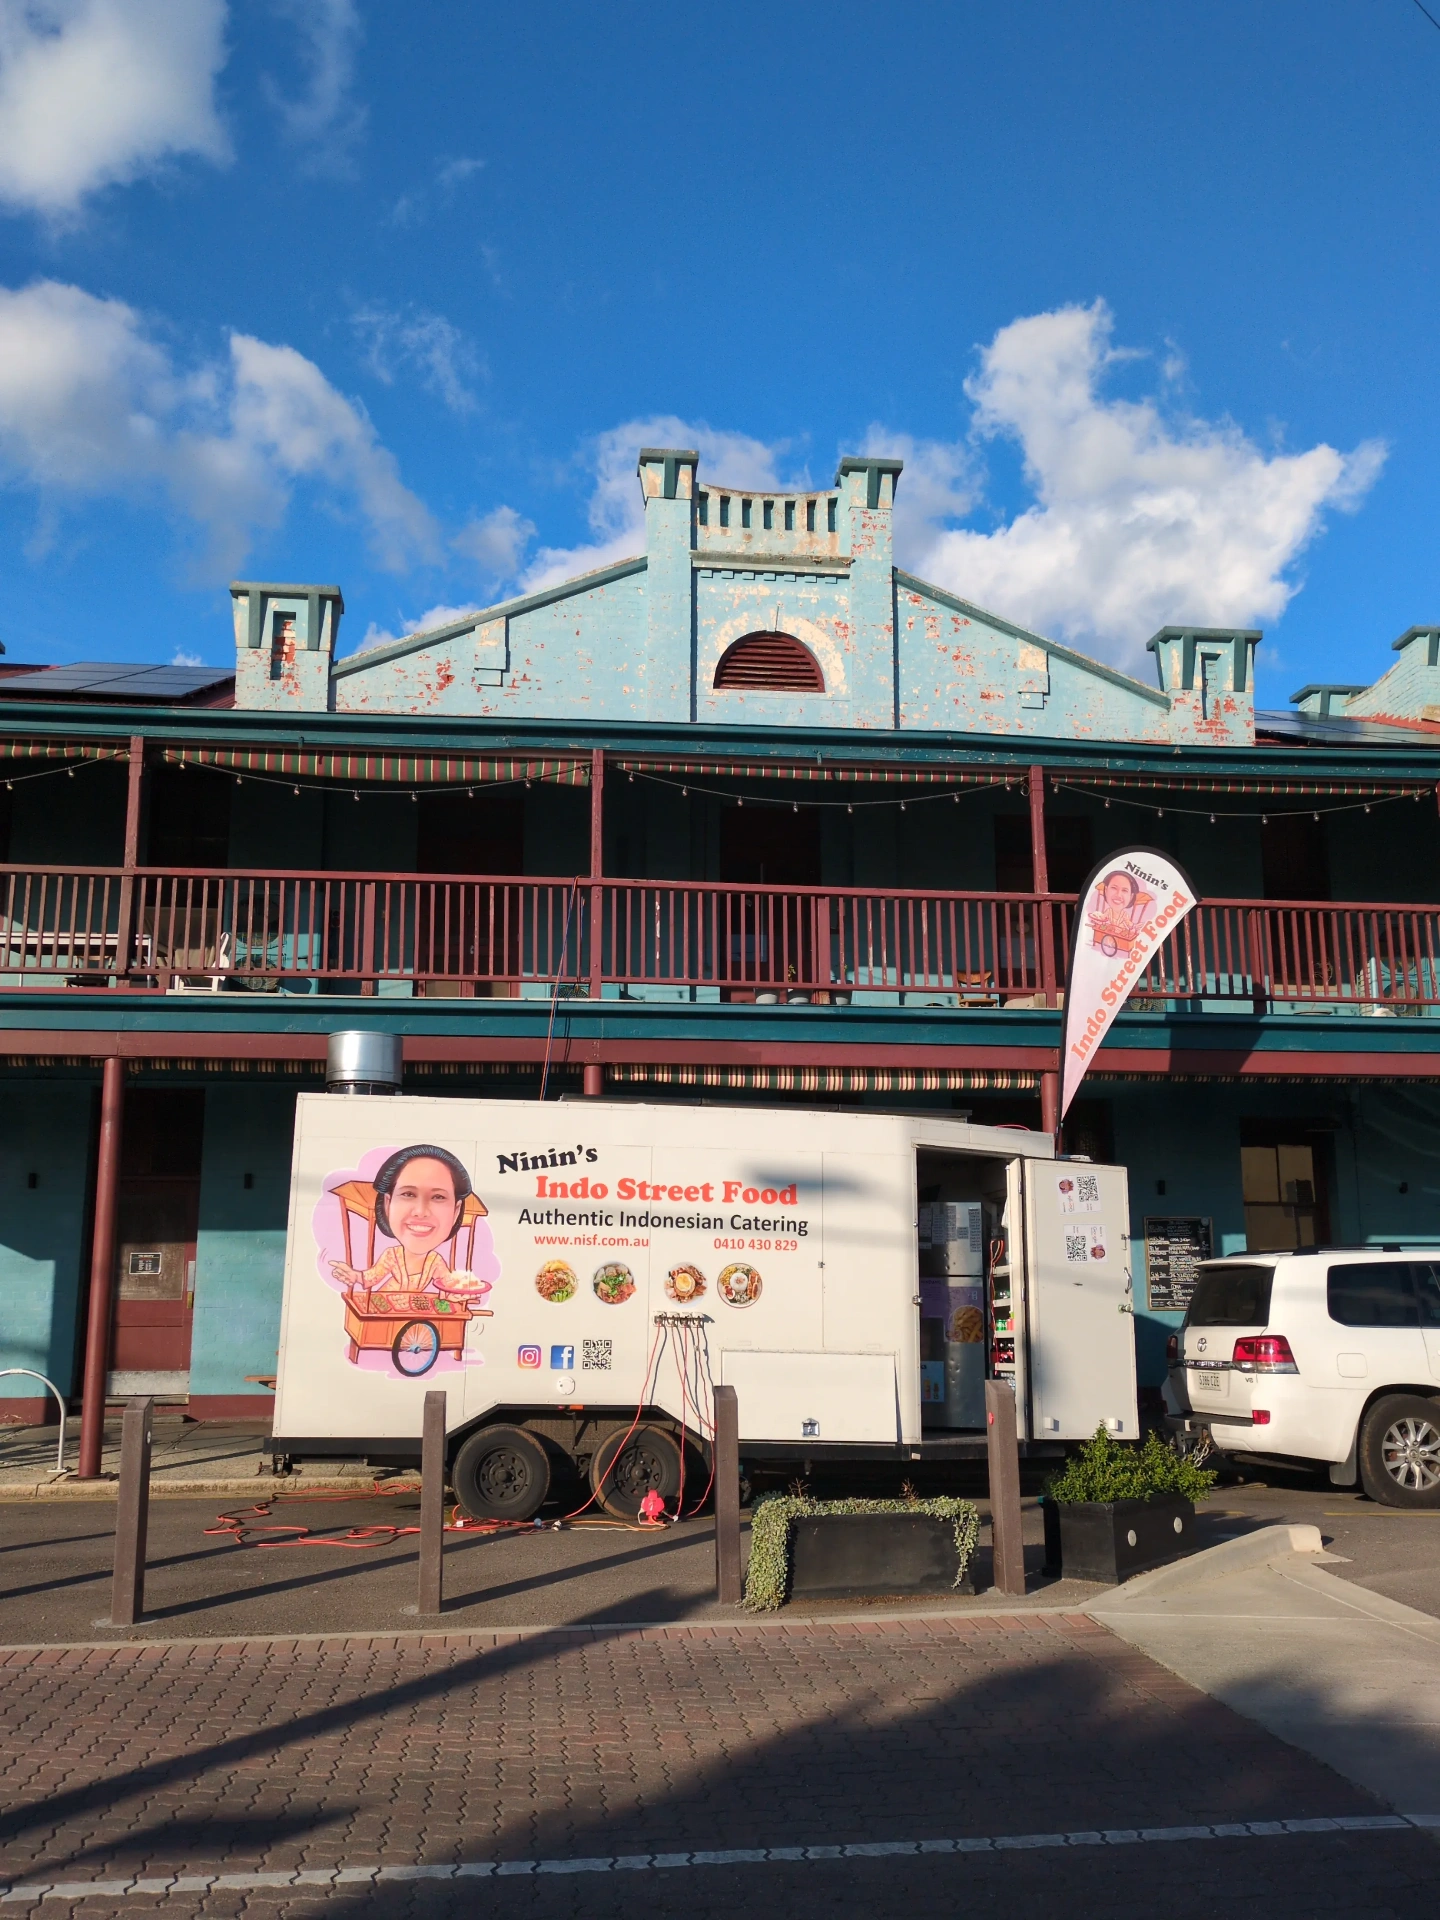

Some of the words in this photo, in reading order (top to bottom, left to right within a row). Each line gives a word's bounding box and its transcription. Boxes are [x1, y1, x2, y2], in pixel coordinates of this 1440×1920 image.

[1124, 860, 1169, 891] Ninin's
[1070, 1007, 1107, 1061] Indo
[1101, 937, 1149, 1007] Street
[1141, 891, 1189, 941] Food
[496, 1144, 598, 1174] Ninin's
[536, 1175, 608, 1199] Indo
[616, 1177, 714, 1202] Street
[722, 1181, 798, 1205] Food
[518, 1208, 614, 1226] Authentic
[619, 1211, 724, 1230] Indonesian
[730, 1214, 809, 1237] Catering
[534, 1233, 650, 1247] www.nisf.com.au
[713, 1238, 745, 1250] 0410
[748, 1239, 771, 1250] 430
[774, 1239, 798, 1251] 829
